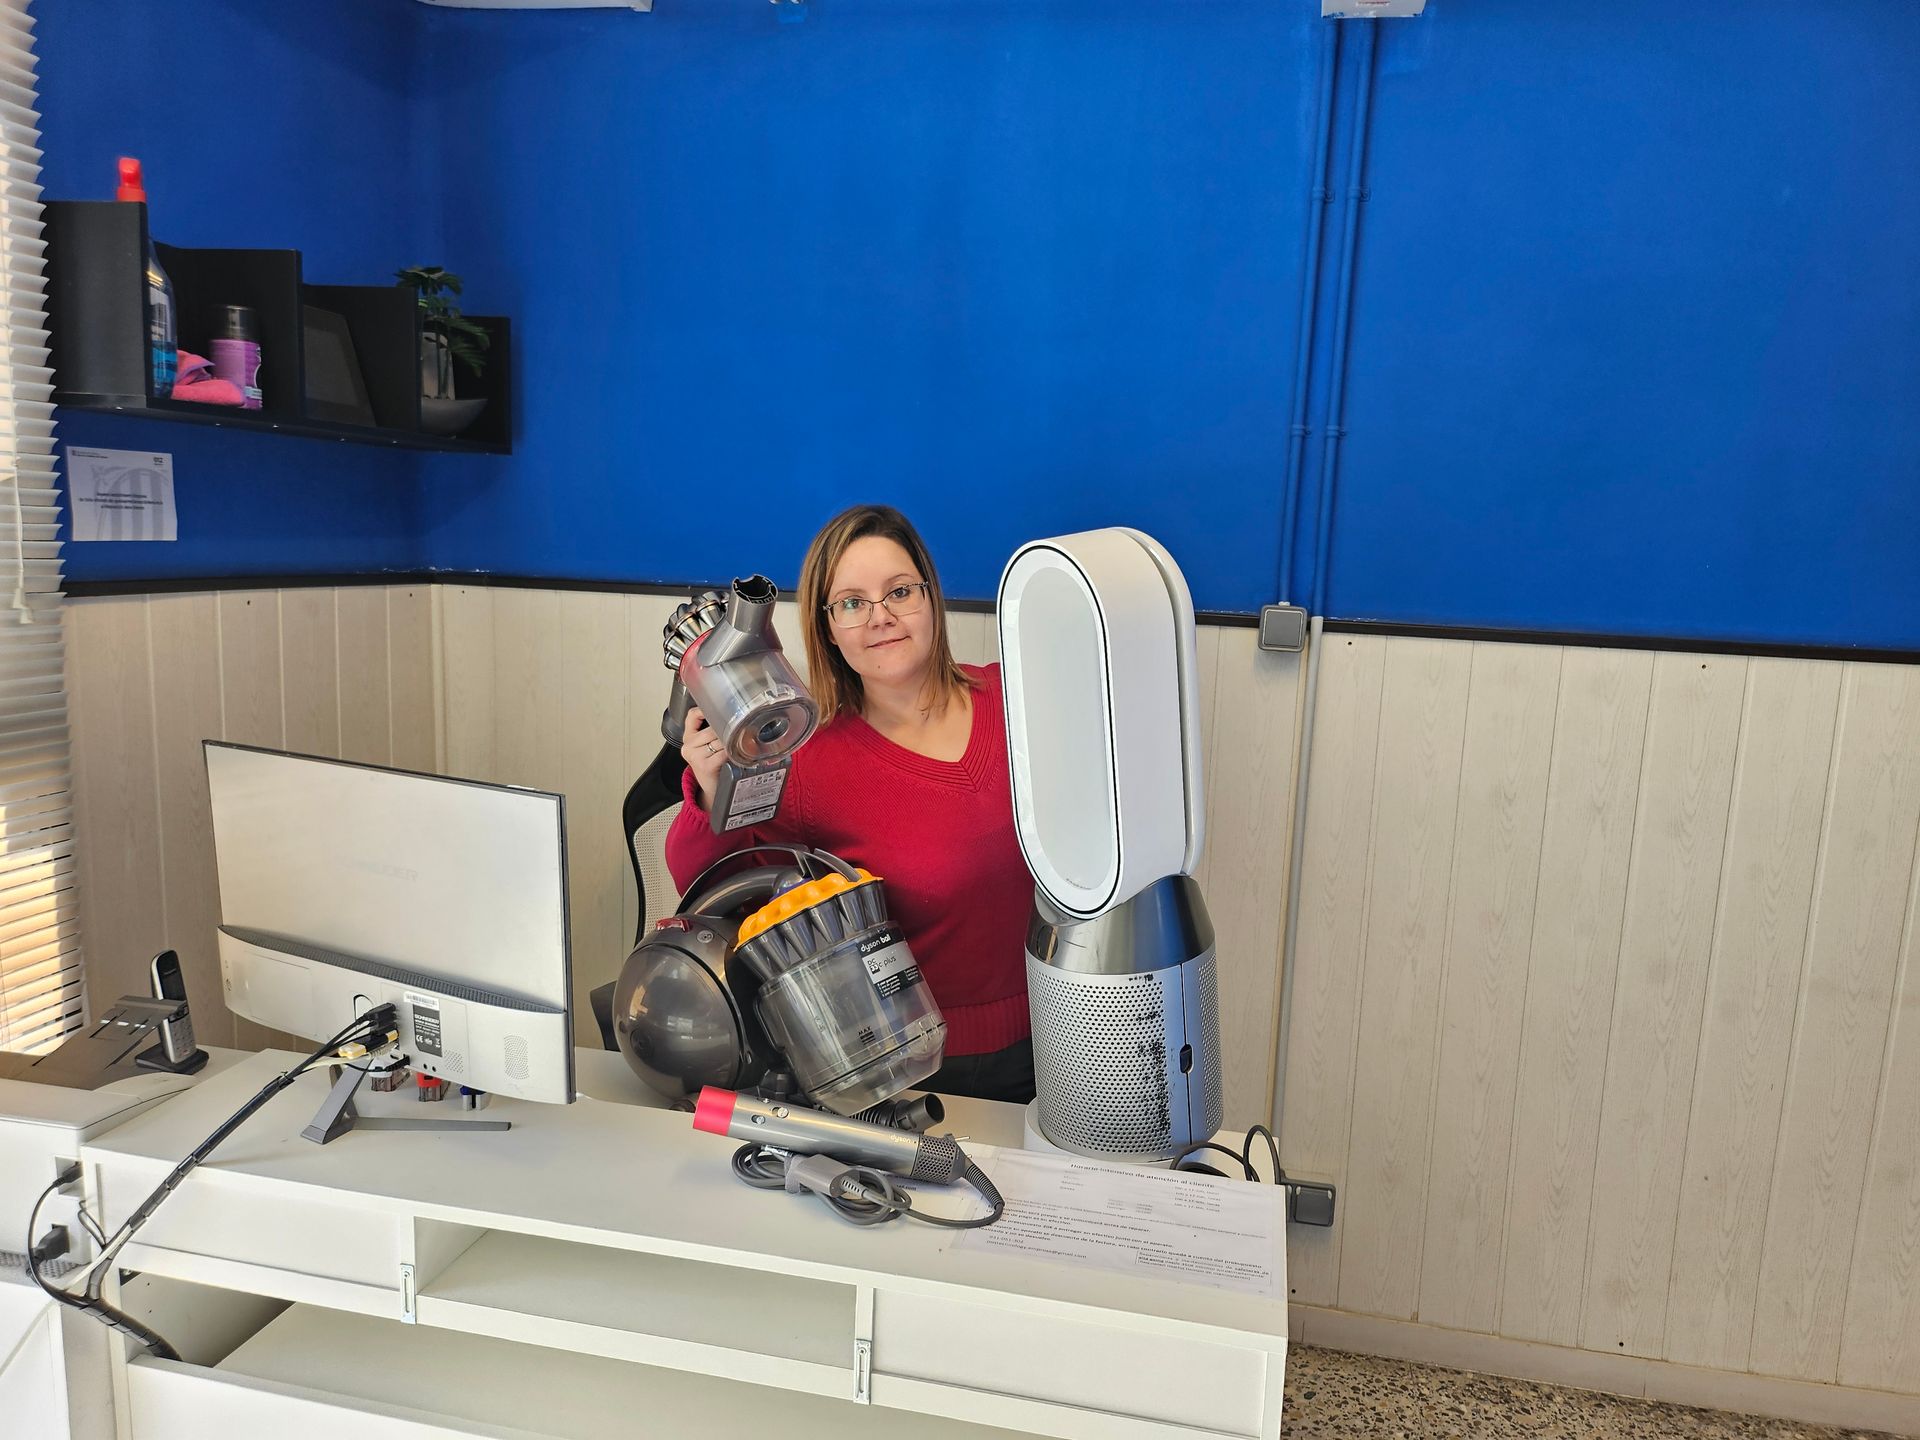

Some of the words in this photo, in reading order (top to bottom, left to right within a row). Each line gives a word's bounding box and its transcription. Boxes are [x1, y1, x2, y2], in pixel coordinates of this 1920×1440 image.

[861, 941, 880, 952] dyson
[884, 955, 897, 967] plus
[858, 1026, 871, 1036] MAX
[890, 1134, 911, 1144] dyson
